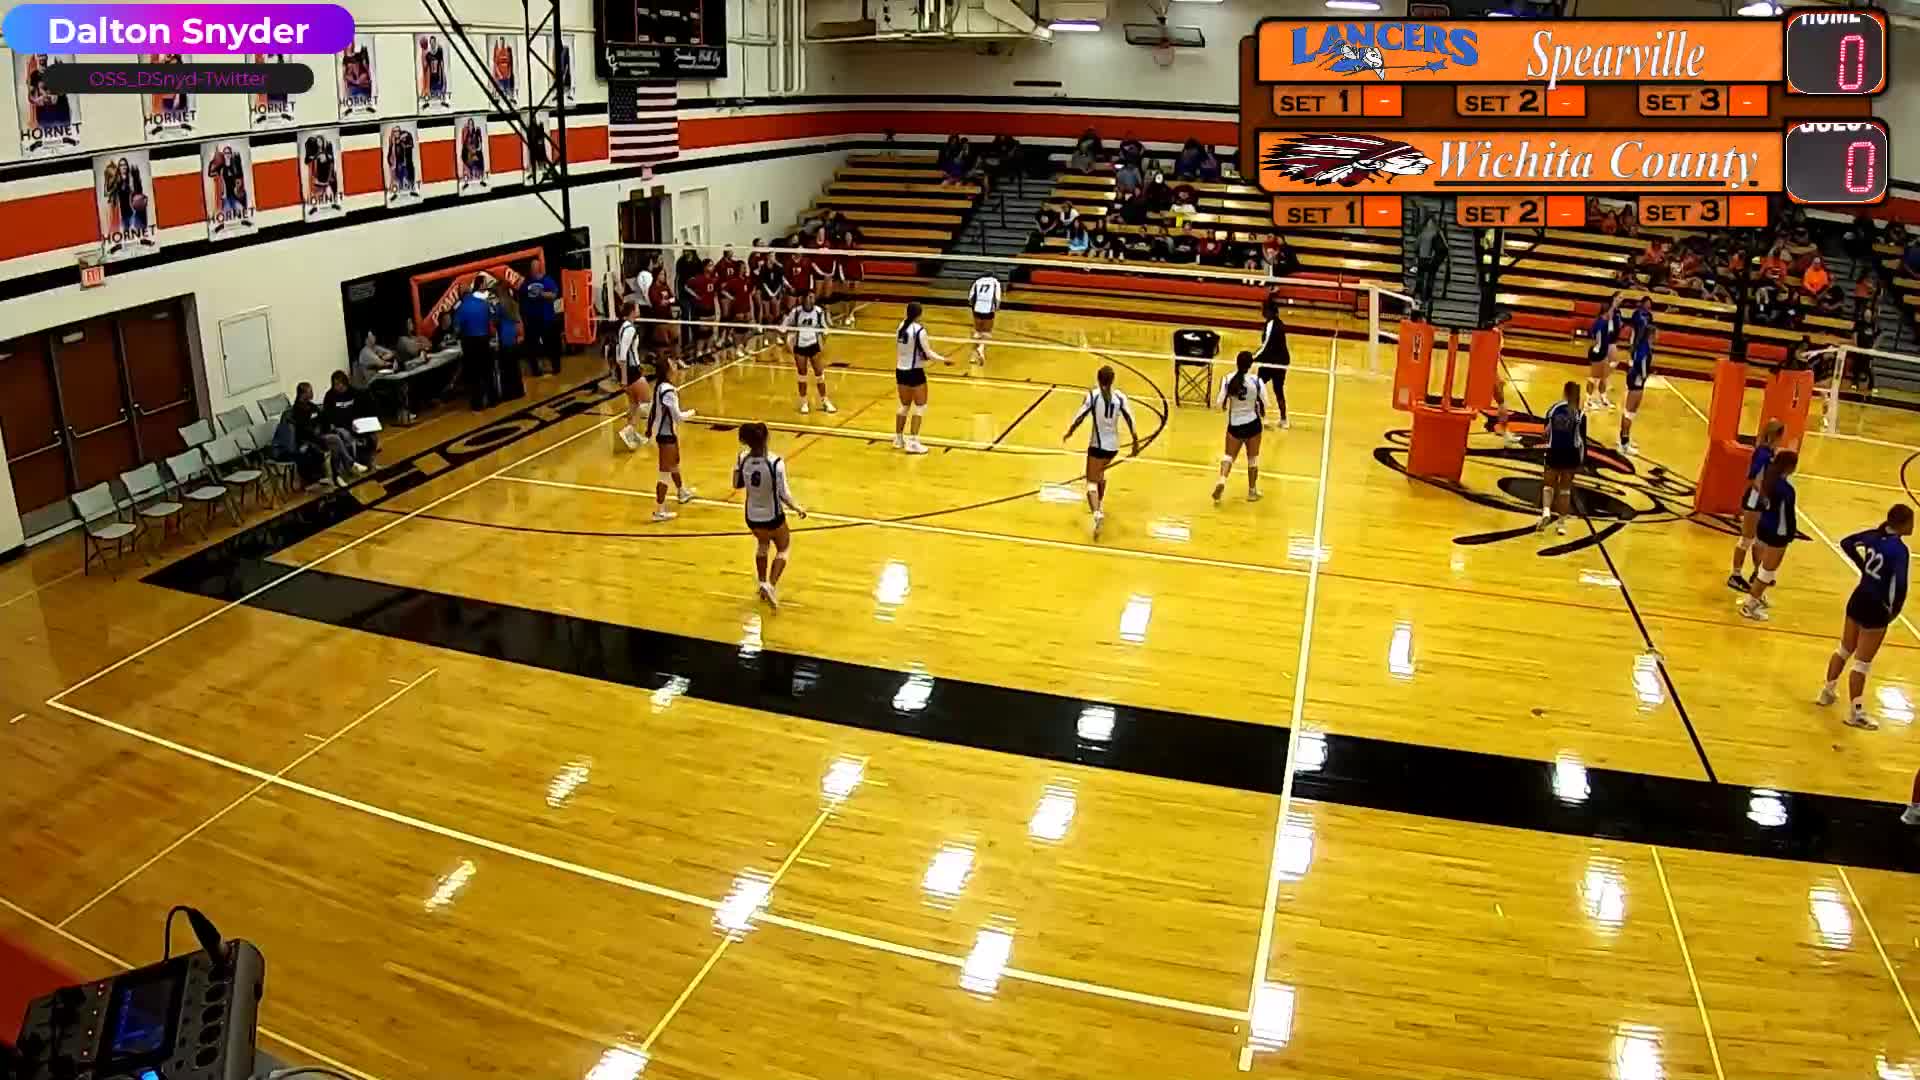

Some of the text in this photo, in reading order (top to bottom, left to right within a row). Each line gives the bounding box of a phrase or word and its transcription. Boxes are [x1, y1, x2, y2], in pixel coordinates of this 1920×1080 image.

[251, 101, 296, 114] HORNET
[144, 110, 197, 126] HORNET
[20, 122, 82, 141] HORNET
[102, 224, 156, 245] HORNET
[979, 284, 991, 294] 17
[1864, 547, 1885, 580] 22
